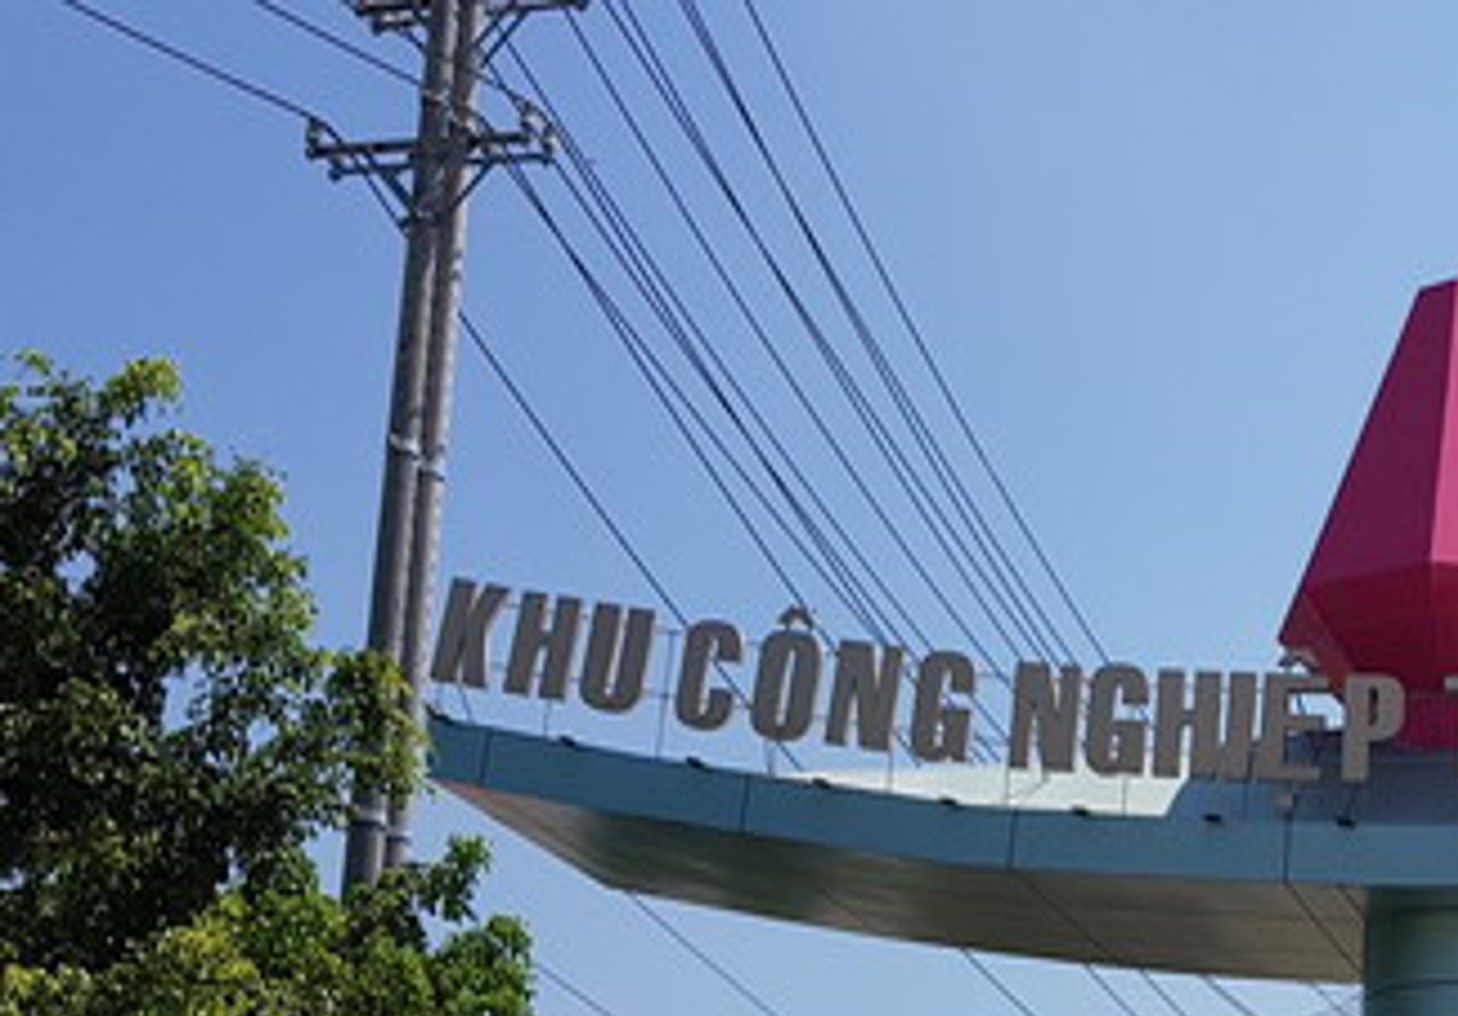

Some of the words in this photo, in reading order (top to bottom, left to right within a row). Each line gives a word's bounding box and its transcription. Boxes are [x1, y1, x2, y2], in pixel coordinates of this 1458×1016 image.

[430, 577, 656, 715] KHU
[674, 604, 976, 764] CÔNG
[1008, 650, 1406, 816] NGHIỆP
